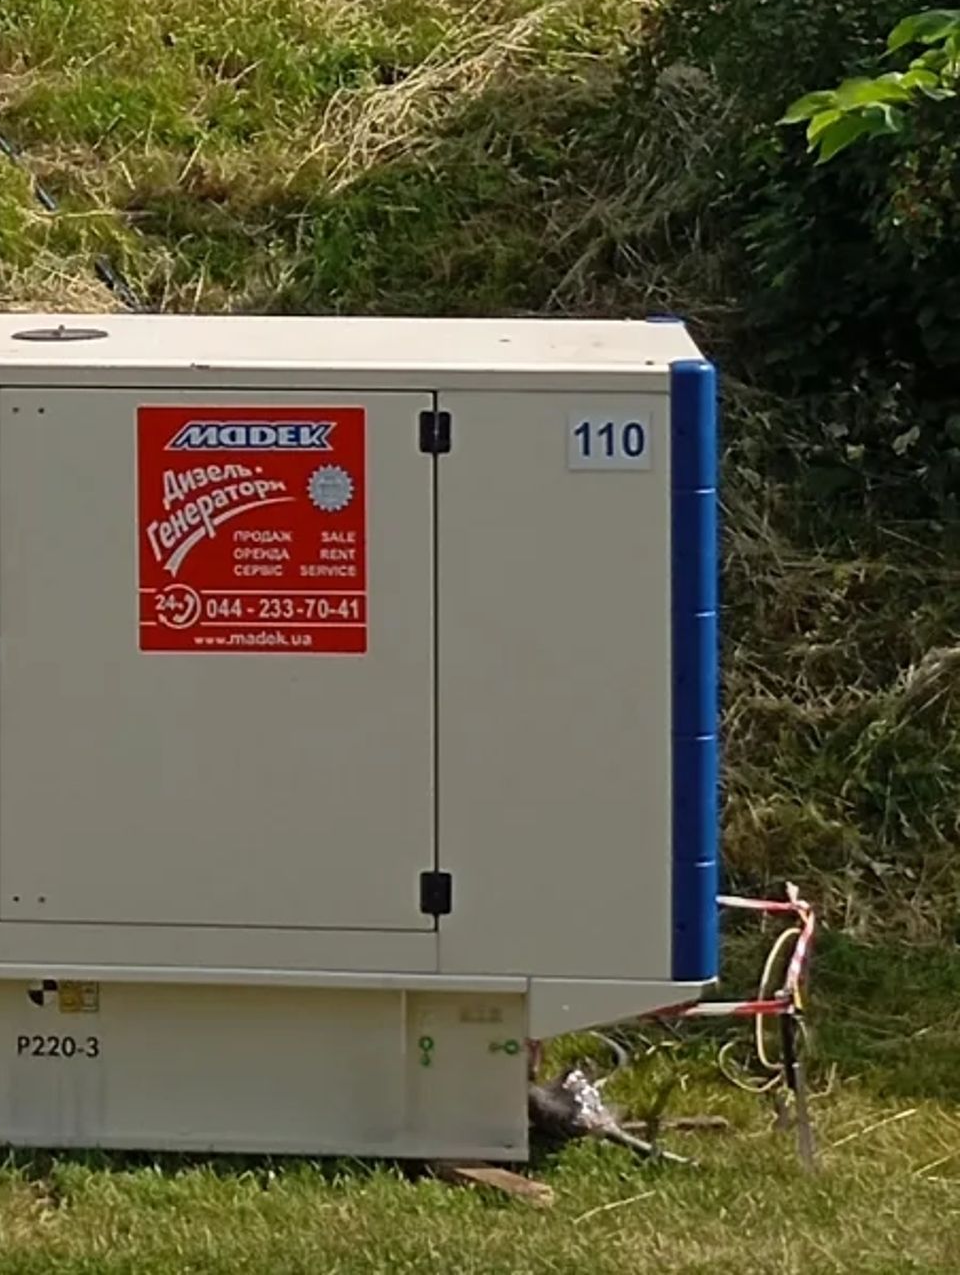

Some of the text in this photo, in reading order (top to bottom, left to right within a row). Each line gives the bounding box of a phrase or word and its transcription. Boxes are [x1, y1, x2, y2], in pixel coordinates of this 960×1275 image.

[174, 424, 326, 446] MADEK
[574, 422, 644, 457] 110
[146, 480, 287, 561] Генератори
[233, 531, 293, 544] ПРОДАЖ
[320, 531, 357, 543] SALE
[233, 548, 290, 560] ОРЕНДА
[320, 548, 357, 560] RENT
[300, 565, 357, 577] SERVICE
[194, 631, 313, 646] www.madek.ua
[17, 1035, 100, 1058] P220-3
